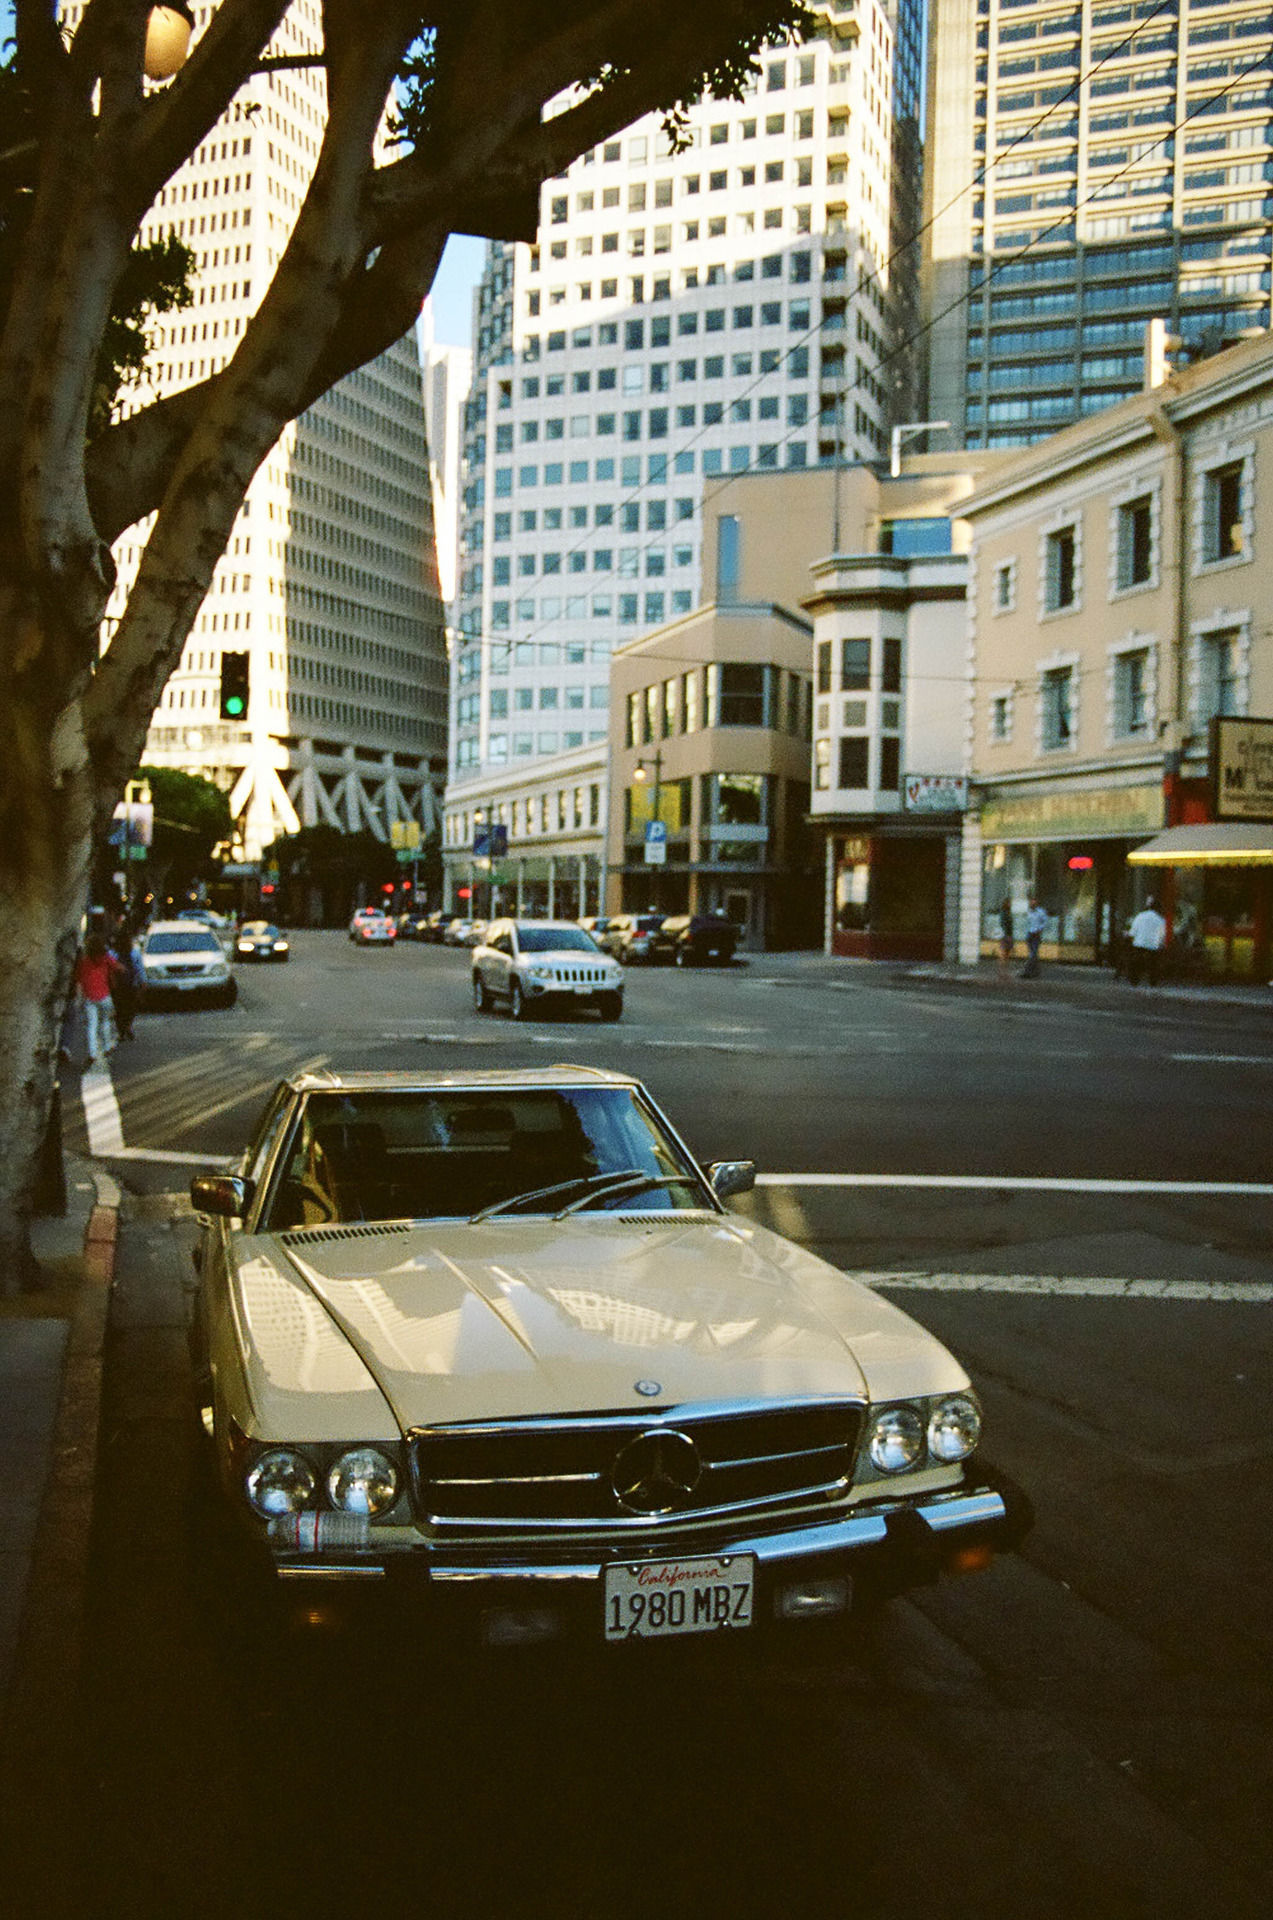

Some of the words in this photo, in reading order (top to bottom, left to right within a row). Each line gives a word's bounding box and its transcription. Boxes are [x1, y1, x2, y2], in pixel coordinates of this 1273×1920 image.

[648, 821, 664, 841] P
[638, 1565, 725, 1586] California
[608, 1590, 685, 1632] 1980
[694, 1583, 751, 1623] MBZ
